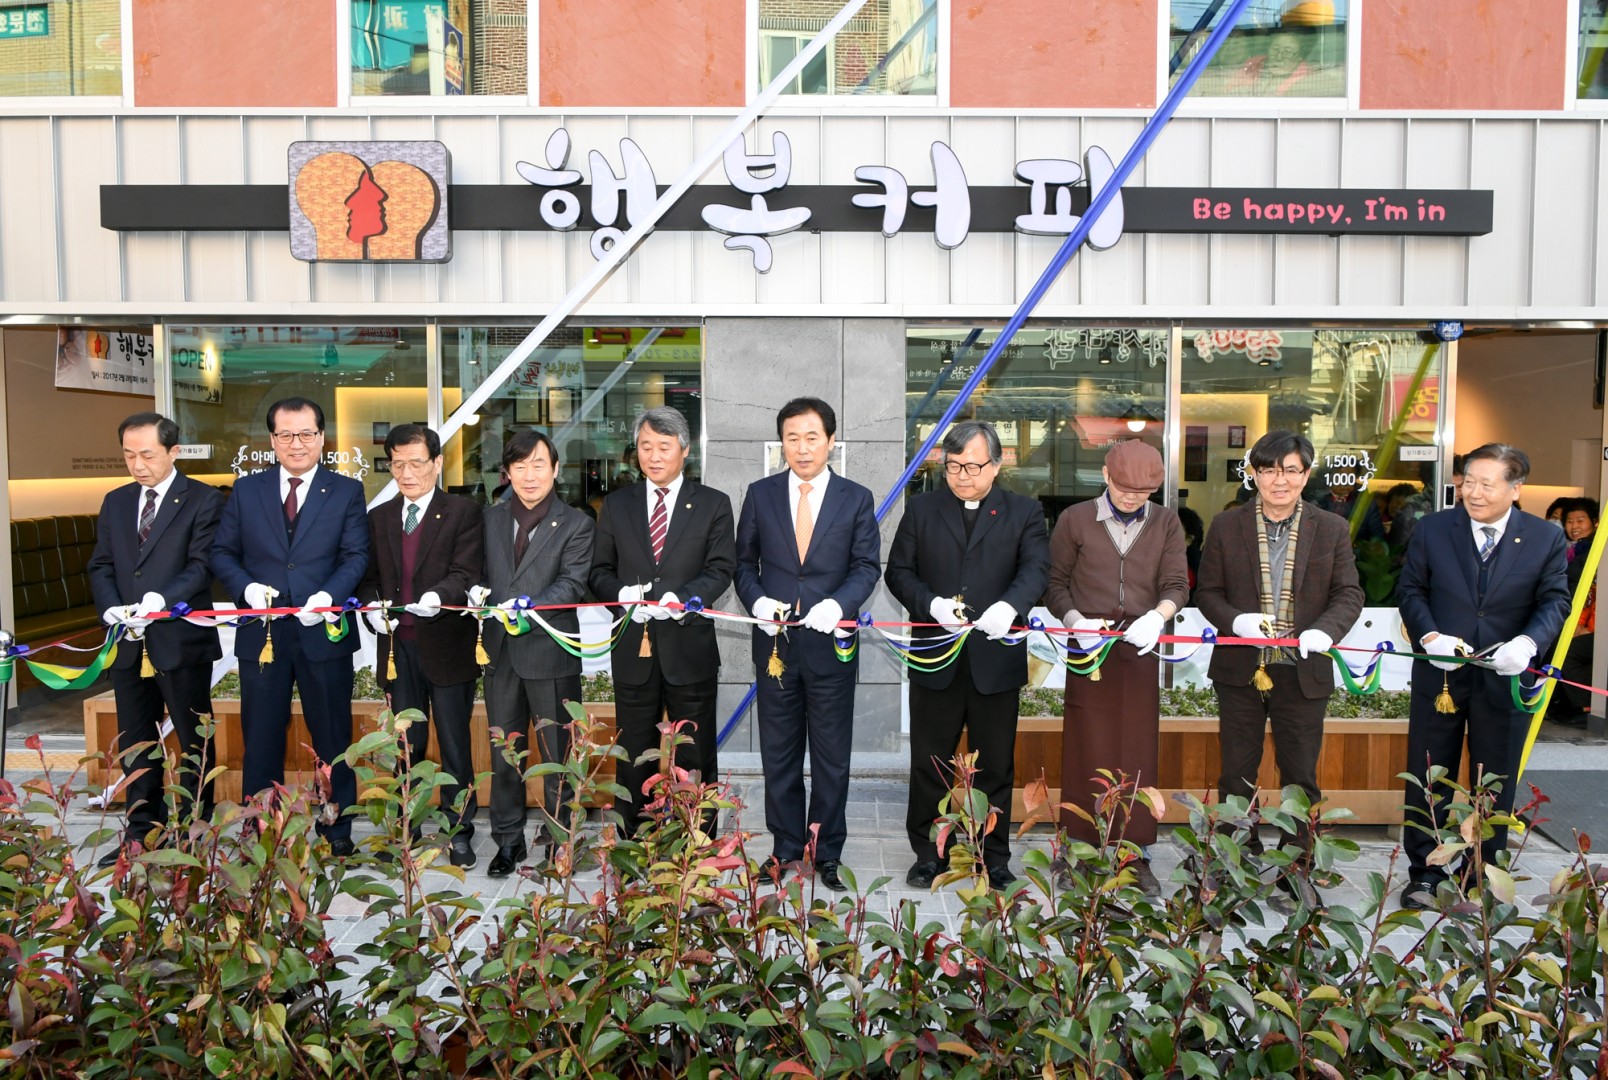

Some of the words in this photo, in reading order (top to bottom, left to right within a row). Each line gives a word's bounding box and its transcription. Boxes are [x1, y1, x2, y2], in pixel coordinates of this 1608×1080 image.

[1193, 198, 1232, 220] Be
[1243, 197, 1352, 225] happy,
[1365, 197, 1408, 221] I'm
[1418, 198, 1446, 221] in
[1442, 322, 1461, 333] ADT
[178, 347, 212, 371] OPEN
[1324, 455, 1357, 469] 1,500
[1324, 473, 1356, 486] 1,000
